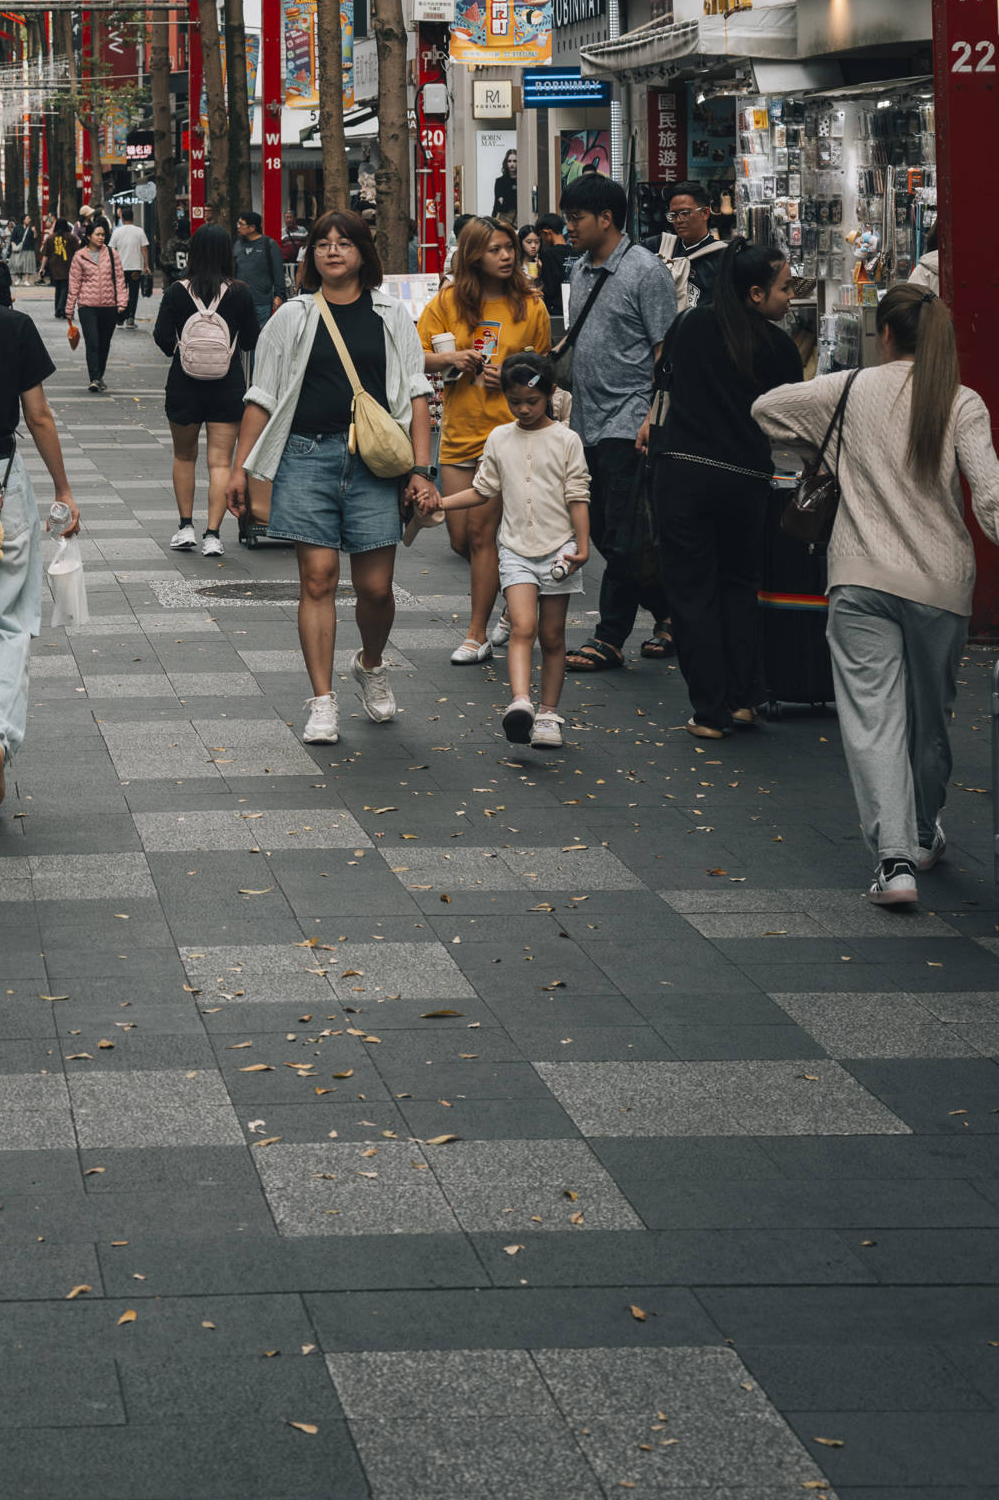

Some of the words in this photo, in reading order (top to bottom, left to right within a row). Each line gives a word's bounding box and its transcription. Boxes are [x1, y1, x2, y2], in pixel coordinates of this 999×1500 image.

[952, 41, 995, 72] 22
[535, 81, 600, 91] ROBINMAY
[266, 133, 279, 145] W
[421, 130, 444, 146] 20
[658, 94, 677, 181] 國民旅遊卡
[191, 150, 202, 159] W
[266, 158, 281, 169] 18
[192, 169, 204, 179] 16
